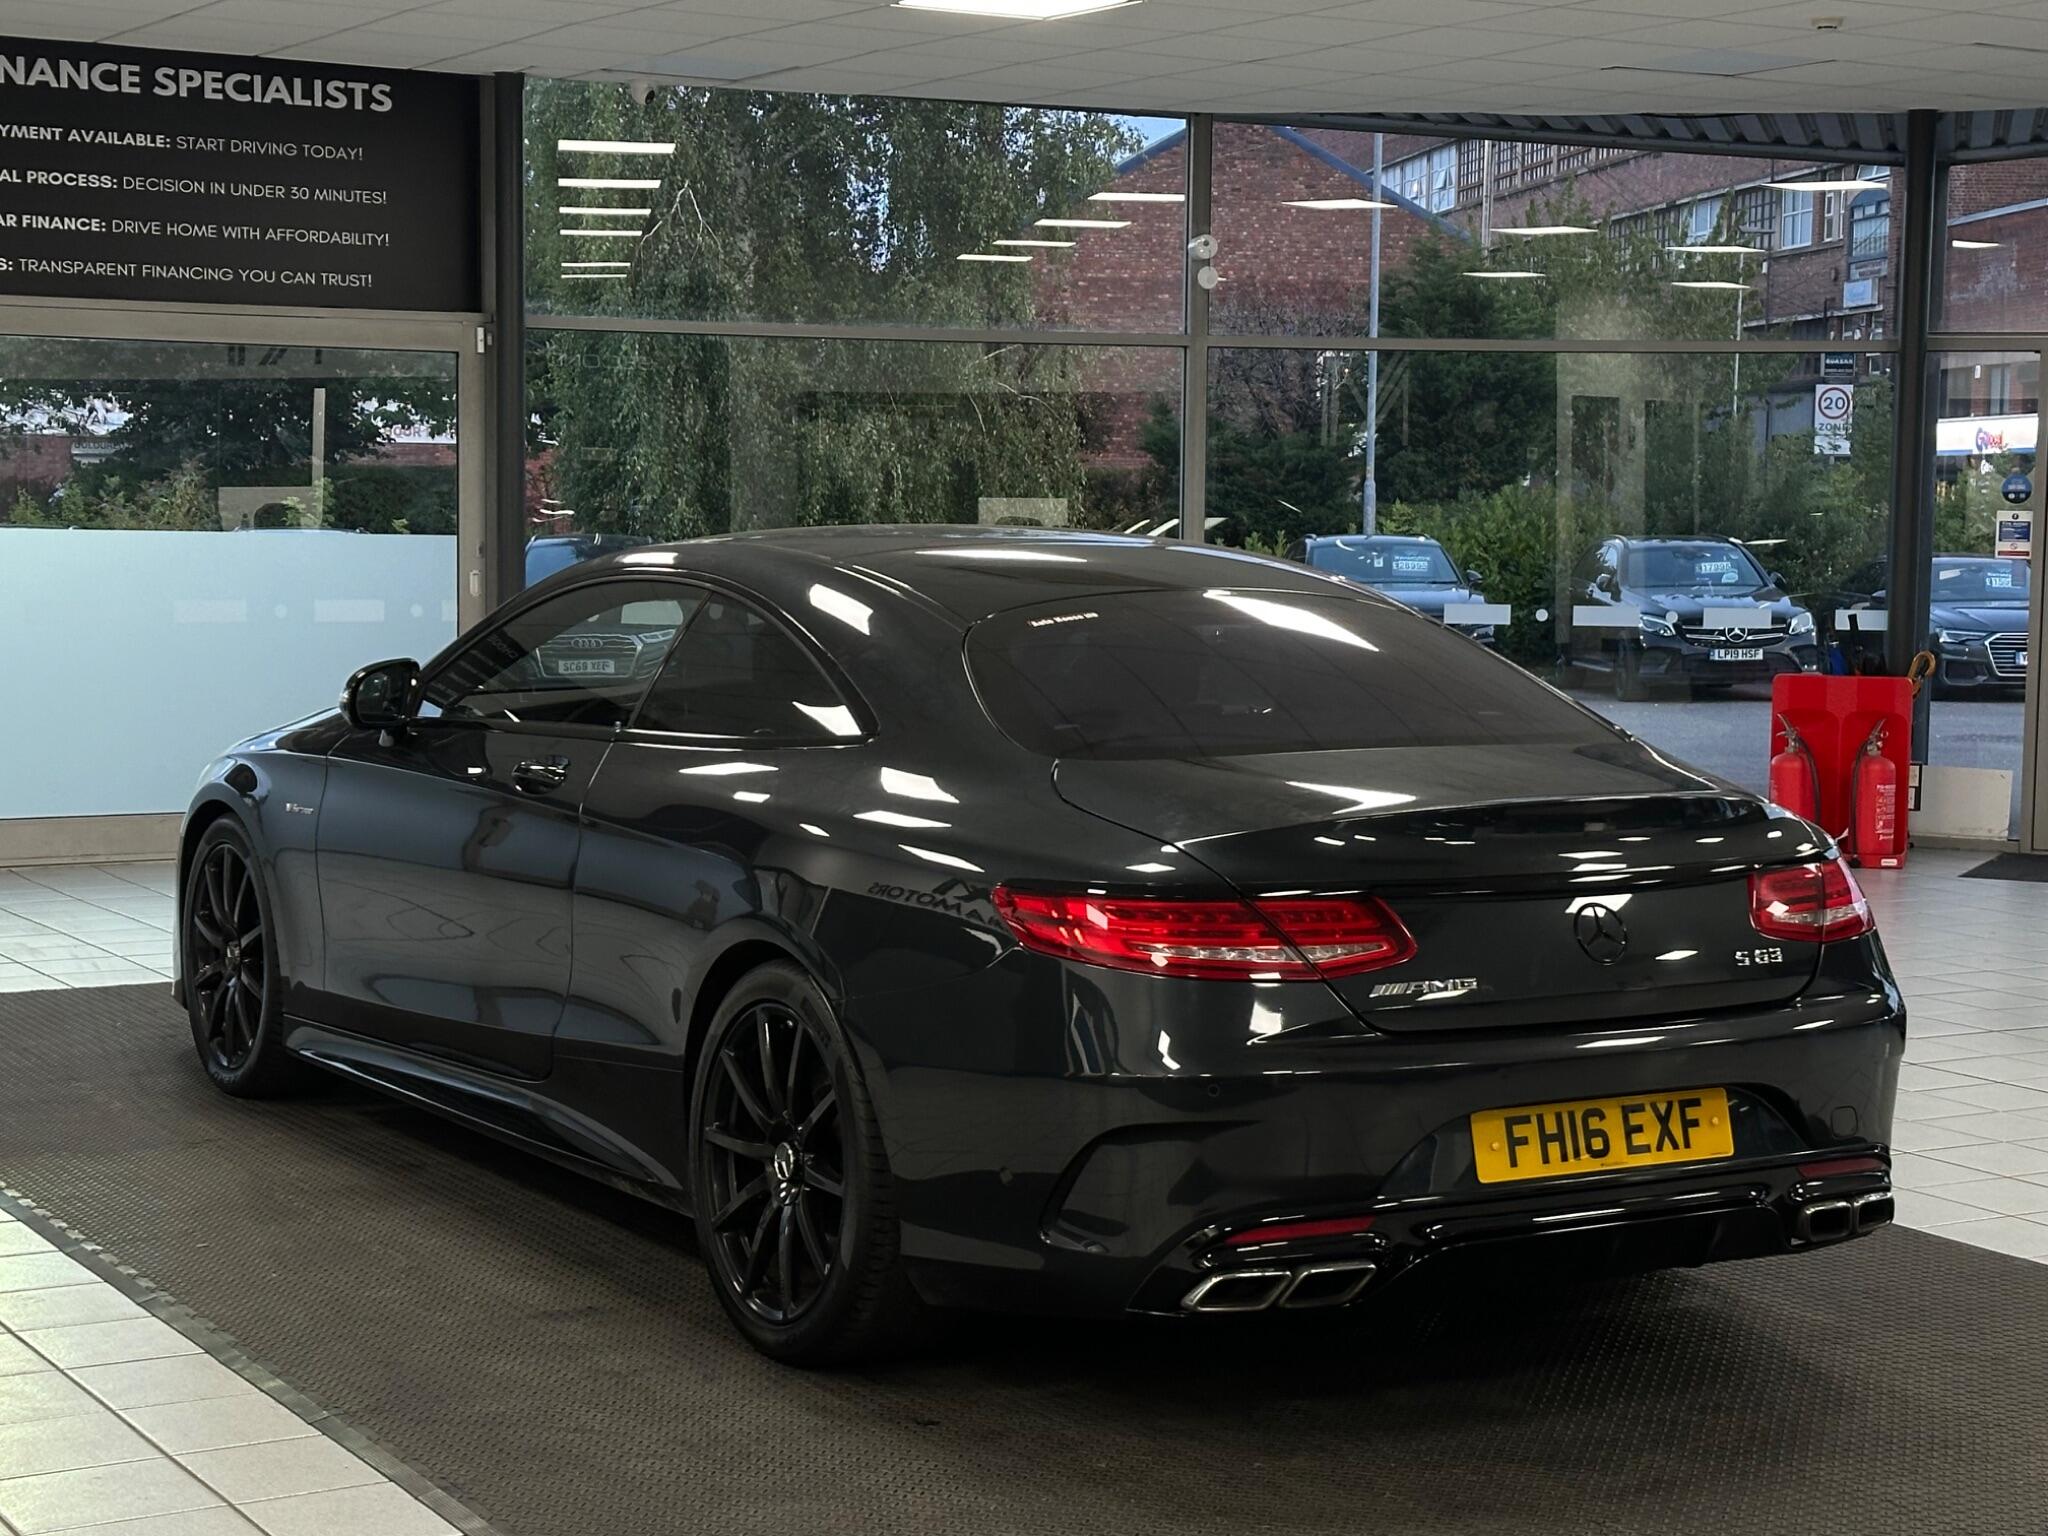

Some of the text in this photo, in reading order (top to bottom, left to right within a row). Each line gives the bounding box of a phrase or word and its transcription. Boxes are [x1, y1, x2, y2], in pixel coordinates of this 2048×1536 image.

[153, 67, 393, 112] SPECIALISTS
[0, 124, 363, 161] YMENT AVAILABLE: START DRIVING TODAY!
[0, 169, 387, 205] AL PROCESS: DECISION IN UNDER 30 MINUTES!
[22, 214, 106, 232] FINANCE:
[112, 219, 161, 235] DRIVE
[167, 222, 217, 238] HOME
[222, 225, 260, 240] WITH
[265, 228, 389, 246] AFFORDABILITY!
[19, 258, 137, 276] TRANSPARENT
[142, 264, 233, 280] FINANCING
[238, 268, 276, 283] YOU
[280, 271, 316, 285] CAN
[320, 272, 372, 288] TRUST!
[1823, 396, 1846, 410] 20
[1717, 648, 1761, 659] LP19 HSF
[1735, 951, 1750, 966] S
[1504, 1098, 1703, 1168] FH16 EXF
